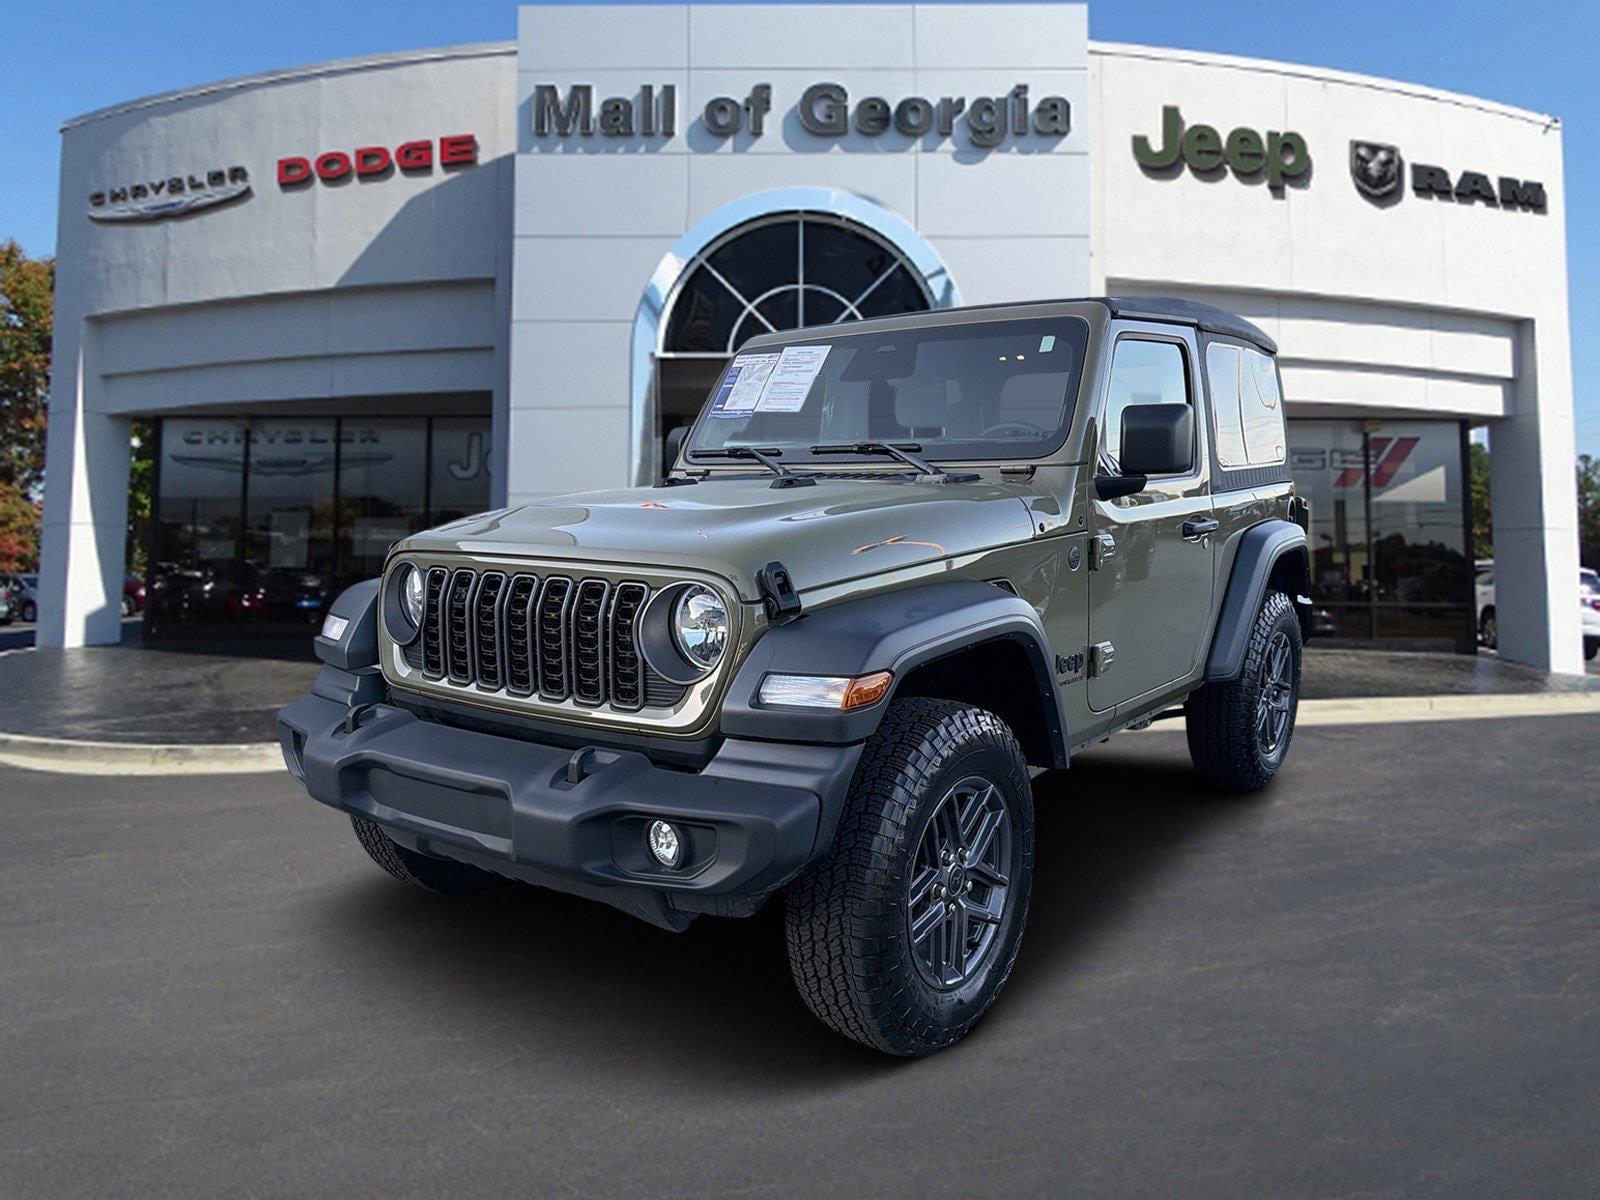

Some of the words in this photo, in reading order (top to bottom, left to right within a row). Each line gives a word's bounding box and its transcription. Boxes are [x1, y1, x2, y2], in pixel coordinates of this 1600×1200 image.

[533, 83, 677, 138] Mall
[704, 84, 773, 137] of
[800, 83, 1073, 149] Georgia
[277, 134, 478, 187] DODGE
[1132, 105, 1311, 194] Jeep
[89, 166, 250, 208] CHRYSLER
[1411, 163, 1548, 214] RAM
[1055, 651, 1084, 675] Jeep
